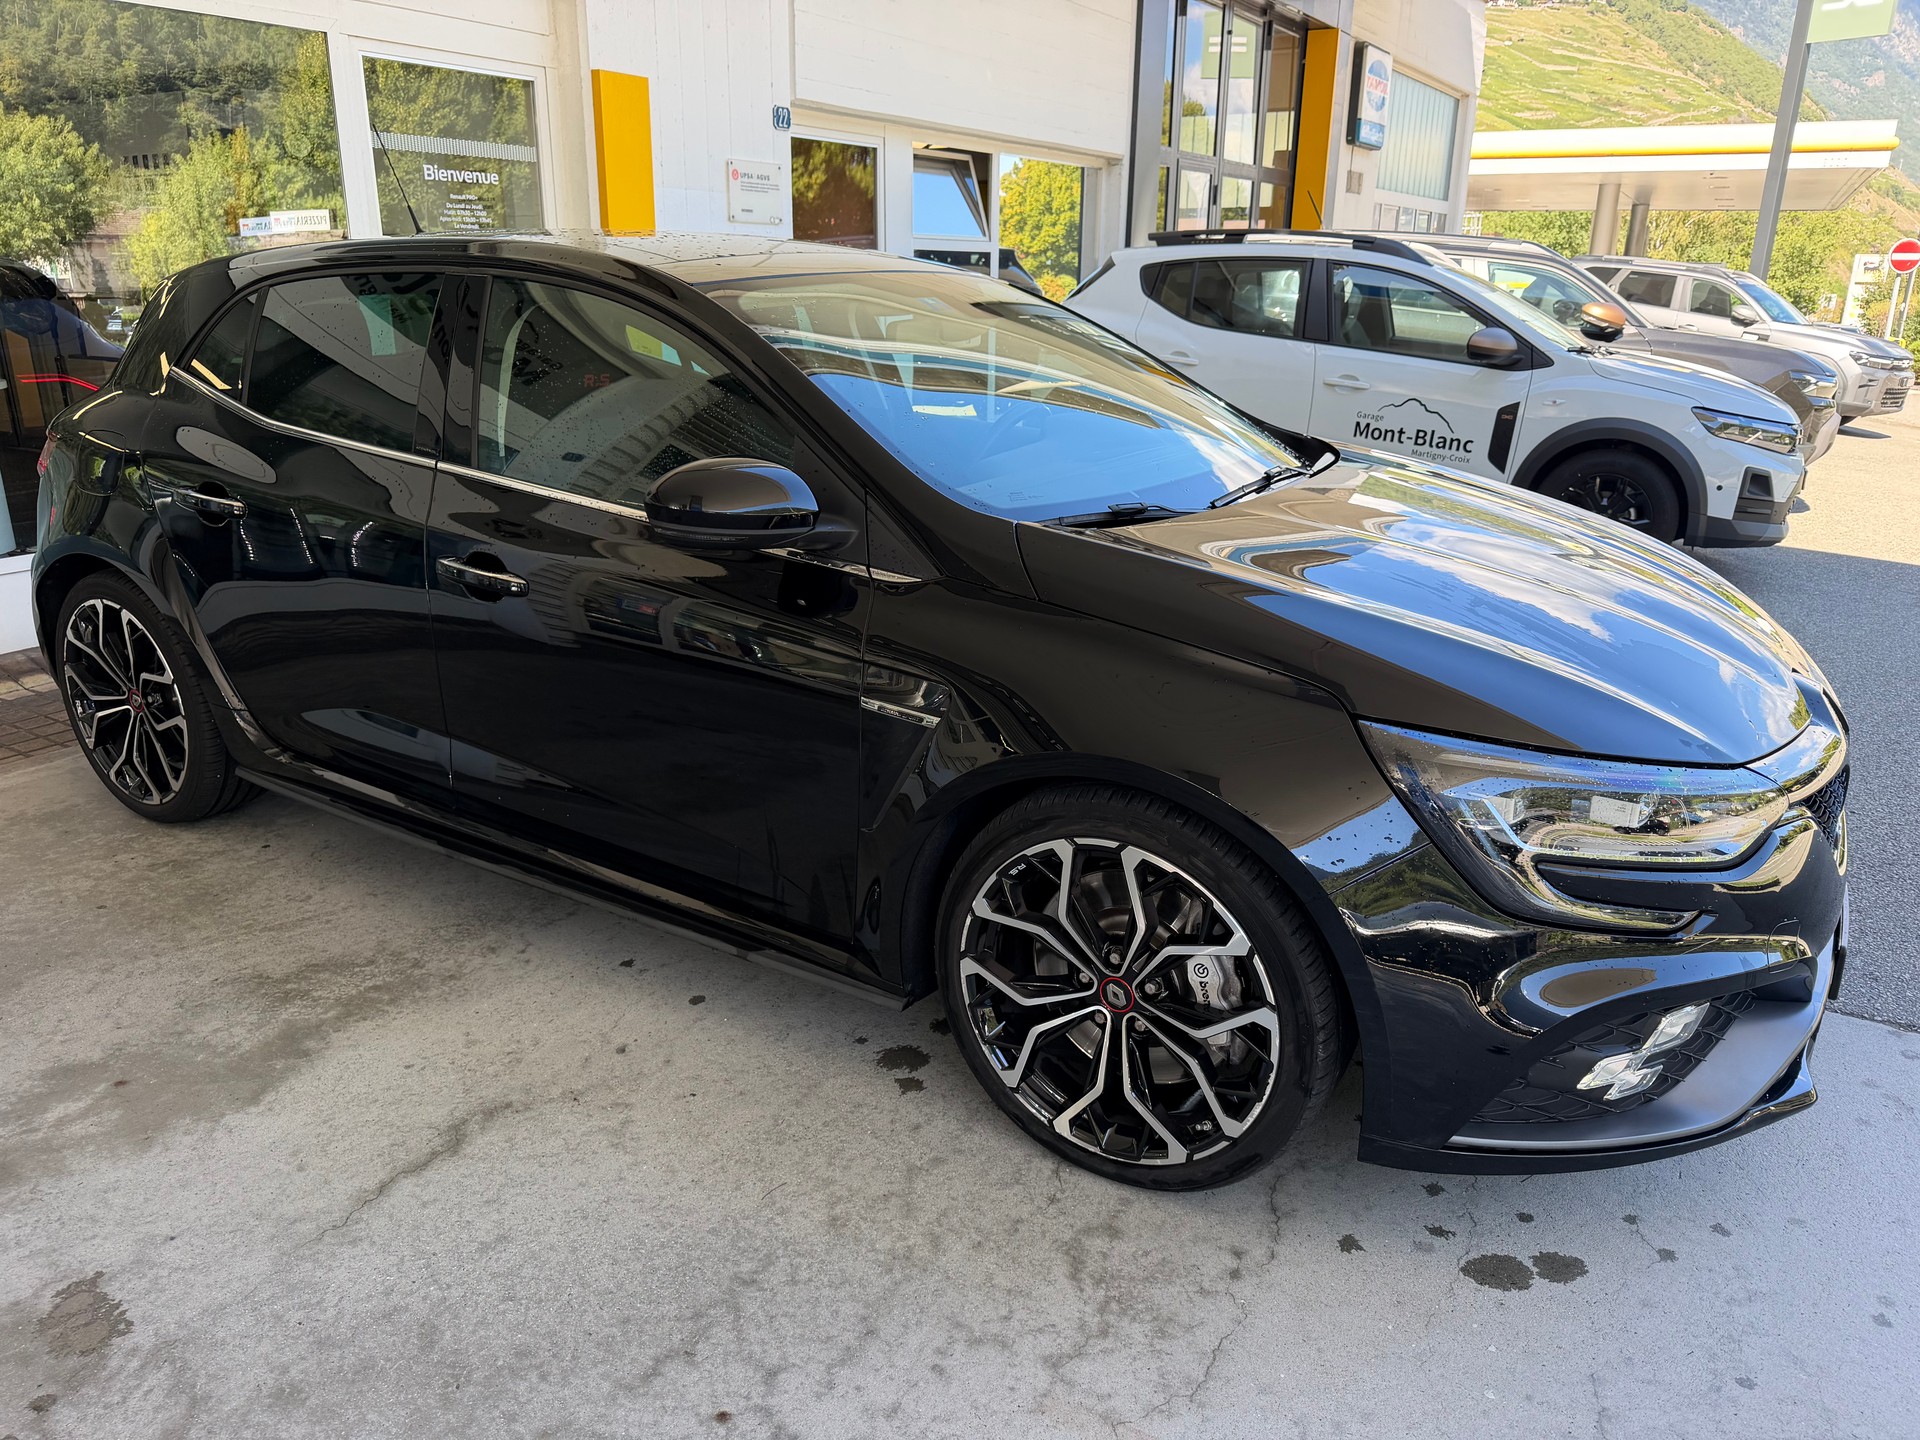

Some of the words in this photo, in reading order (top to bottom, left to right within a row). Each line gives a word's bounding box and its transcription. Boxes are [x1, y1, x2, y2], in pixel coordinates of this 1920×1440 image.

[778, 108, 788, 128] 22
[423, 164, 499, 185] Bienvenue
[740, 172, 753, 180] UPSA
[757, 173, 770, 182] AGVS
[1356, 411, 1385, 422] Garage
[1353, 421, 1474, 453] Mont-Blanc
[1411, 449, 1471, 464] Martigny-Croix
